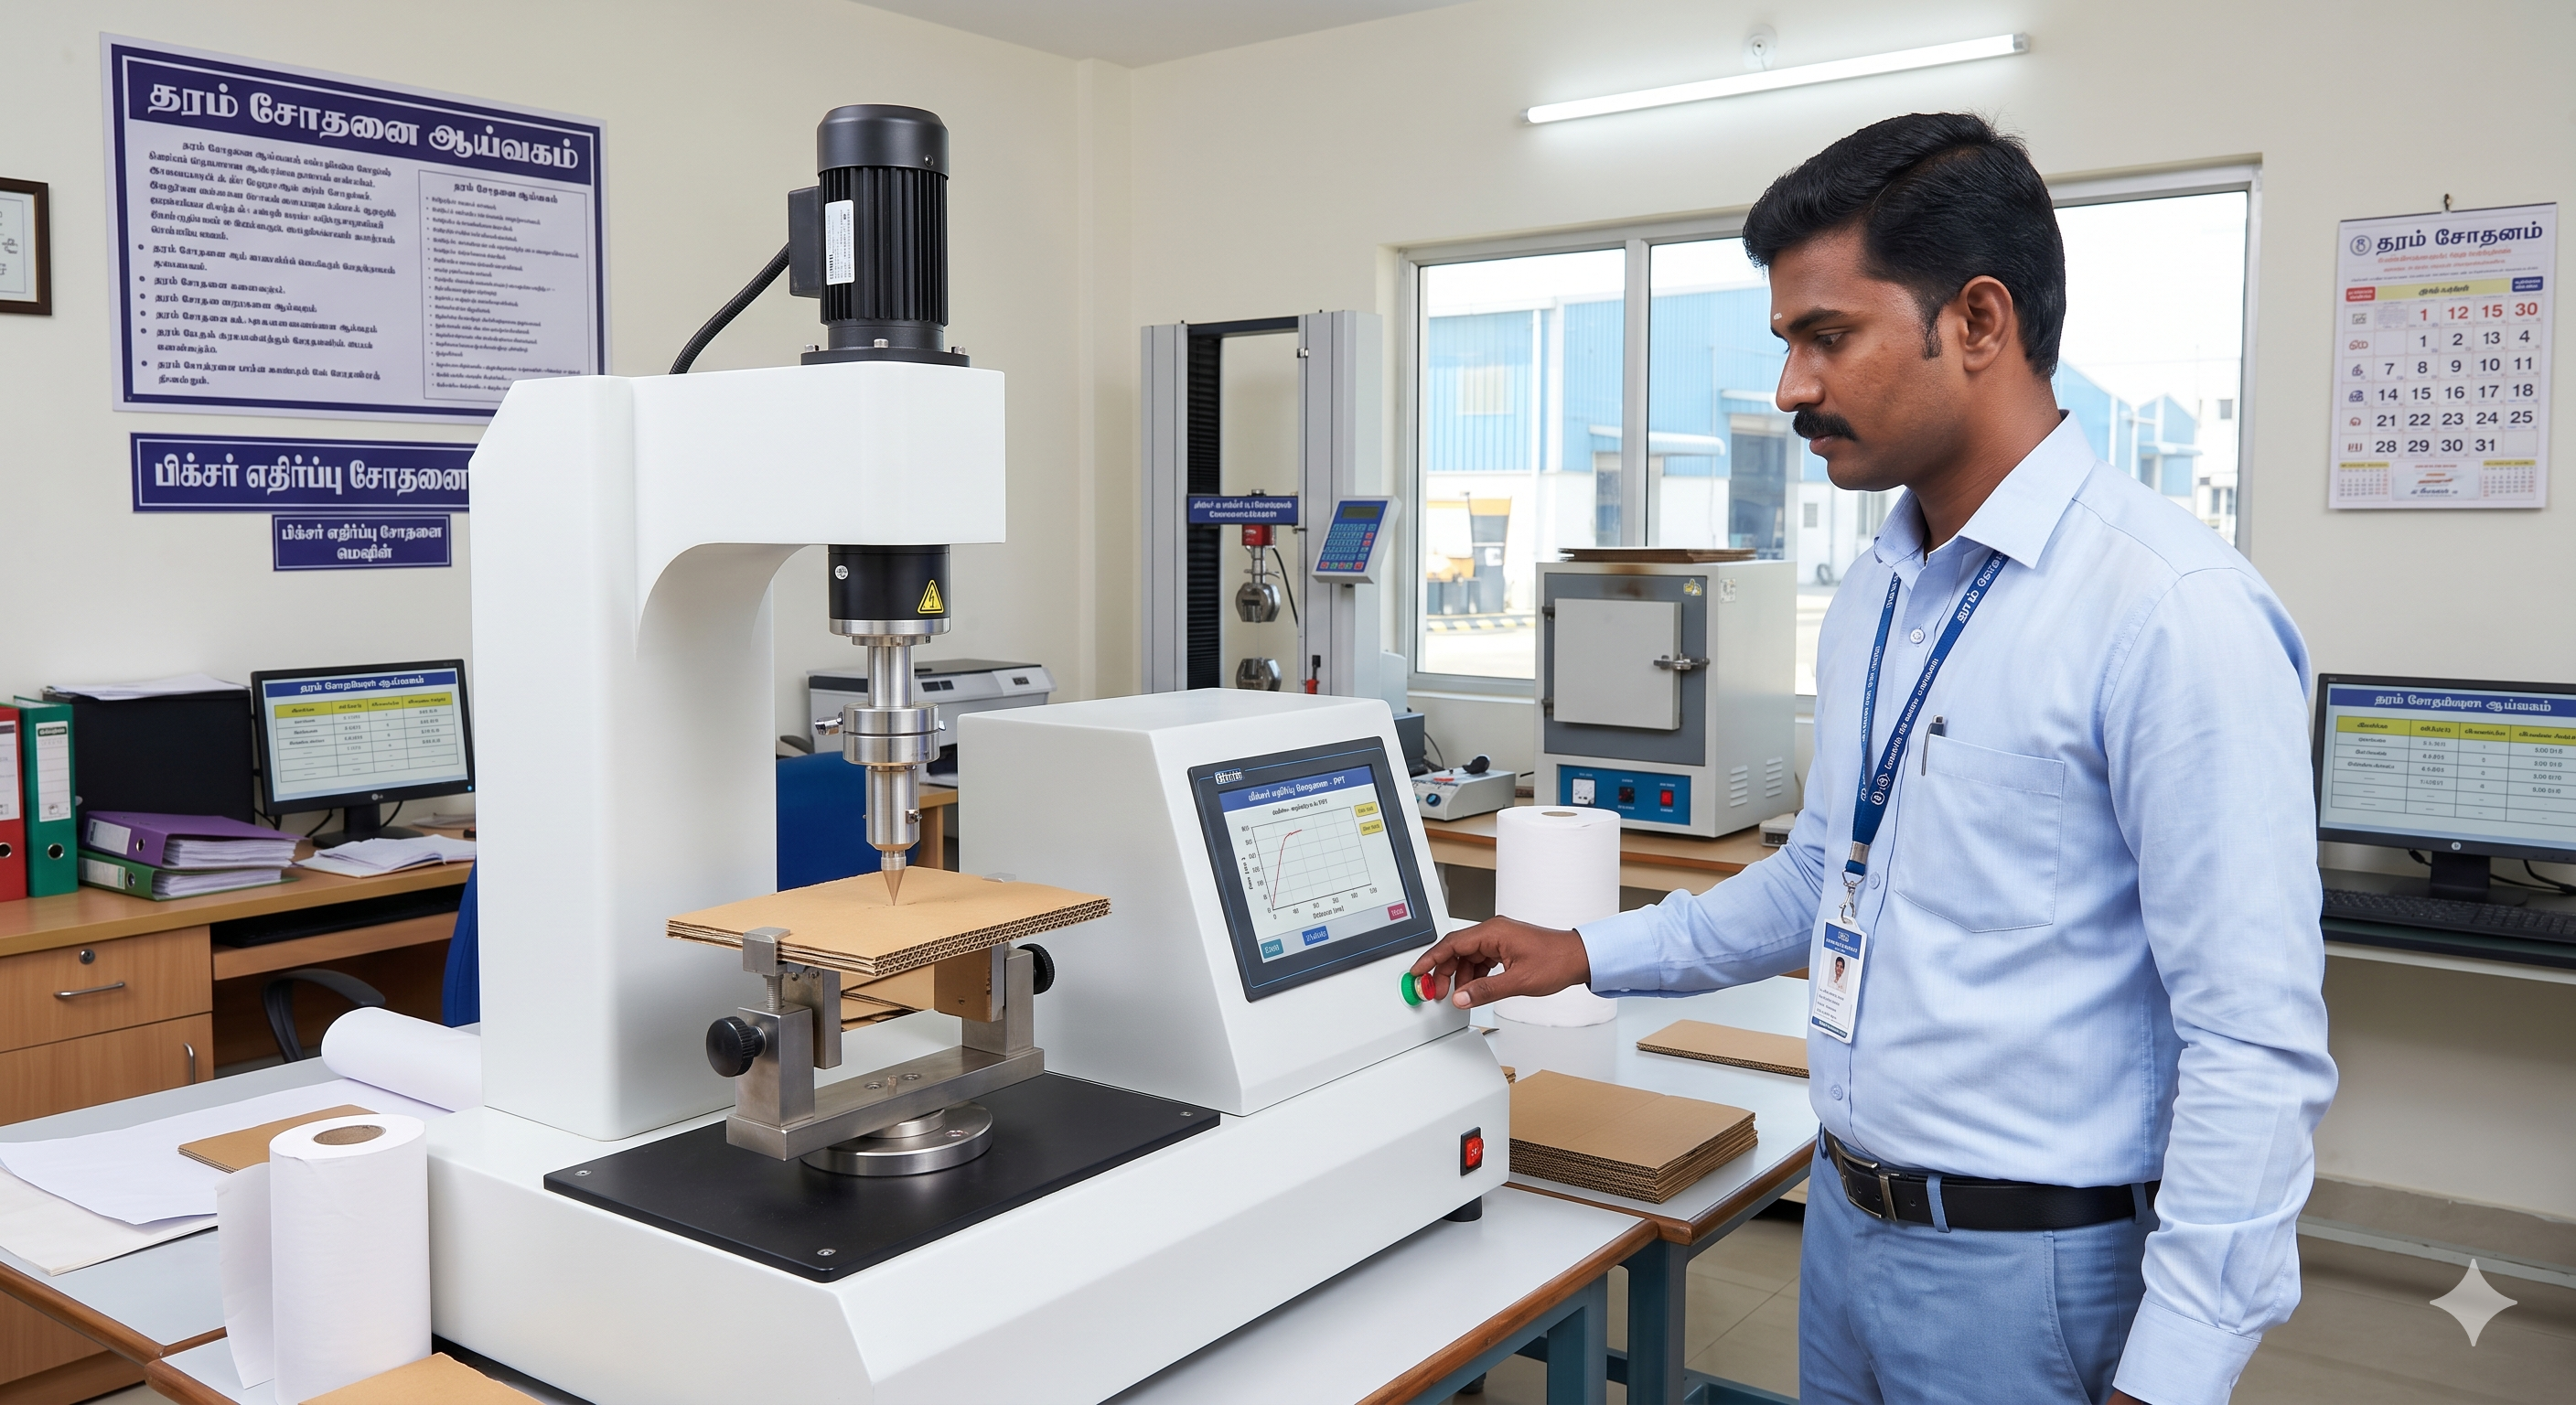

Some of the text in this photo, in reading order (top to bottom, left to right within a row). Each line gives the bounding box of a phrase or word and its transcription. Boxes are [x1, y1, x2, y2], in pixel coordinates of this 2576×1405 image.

[148, 82, 579, 169] தரம் சோதனை ஆய்வகம்
[2376, 220, 2543, 256] தரம் சோதனம்
[2420, 302, 2538, 321] 1 12 15 30
[2420, 330, 2530, 347] 1 2 13 4
[2385, 357, 2532, 375] 7 8 9 10 11
[2378, 383, 2533, 401] 14 15 16 17 18
[2377, 411, 2533, 426] 21 22 23 24 25
[2376, 439, 2495, 453] 28 29 30 31
[155, 452, 469, 497] பிக்சர் எதிர்ப்பு சோதனை
